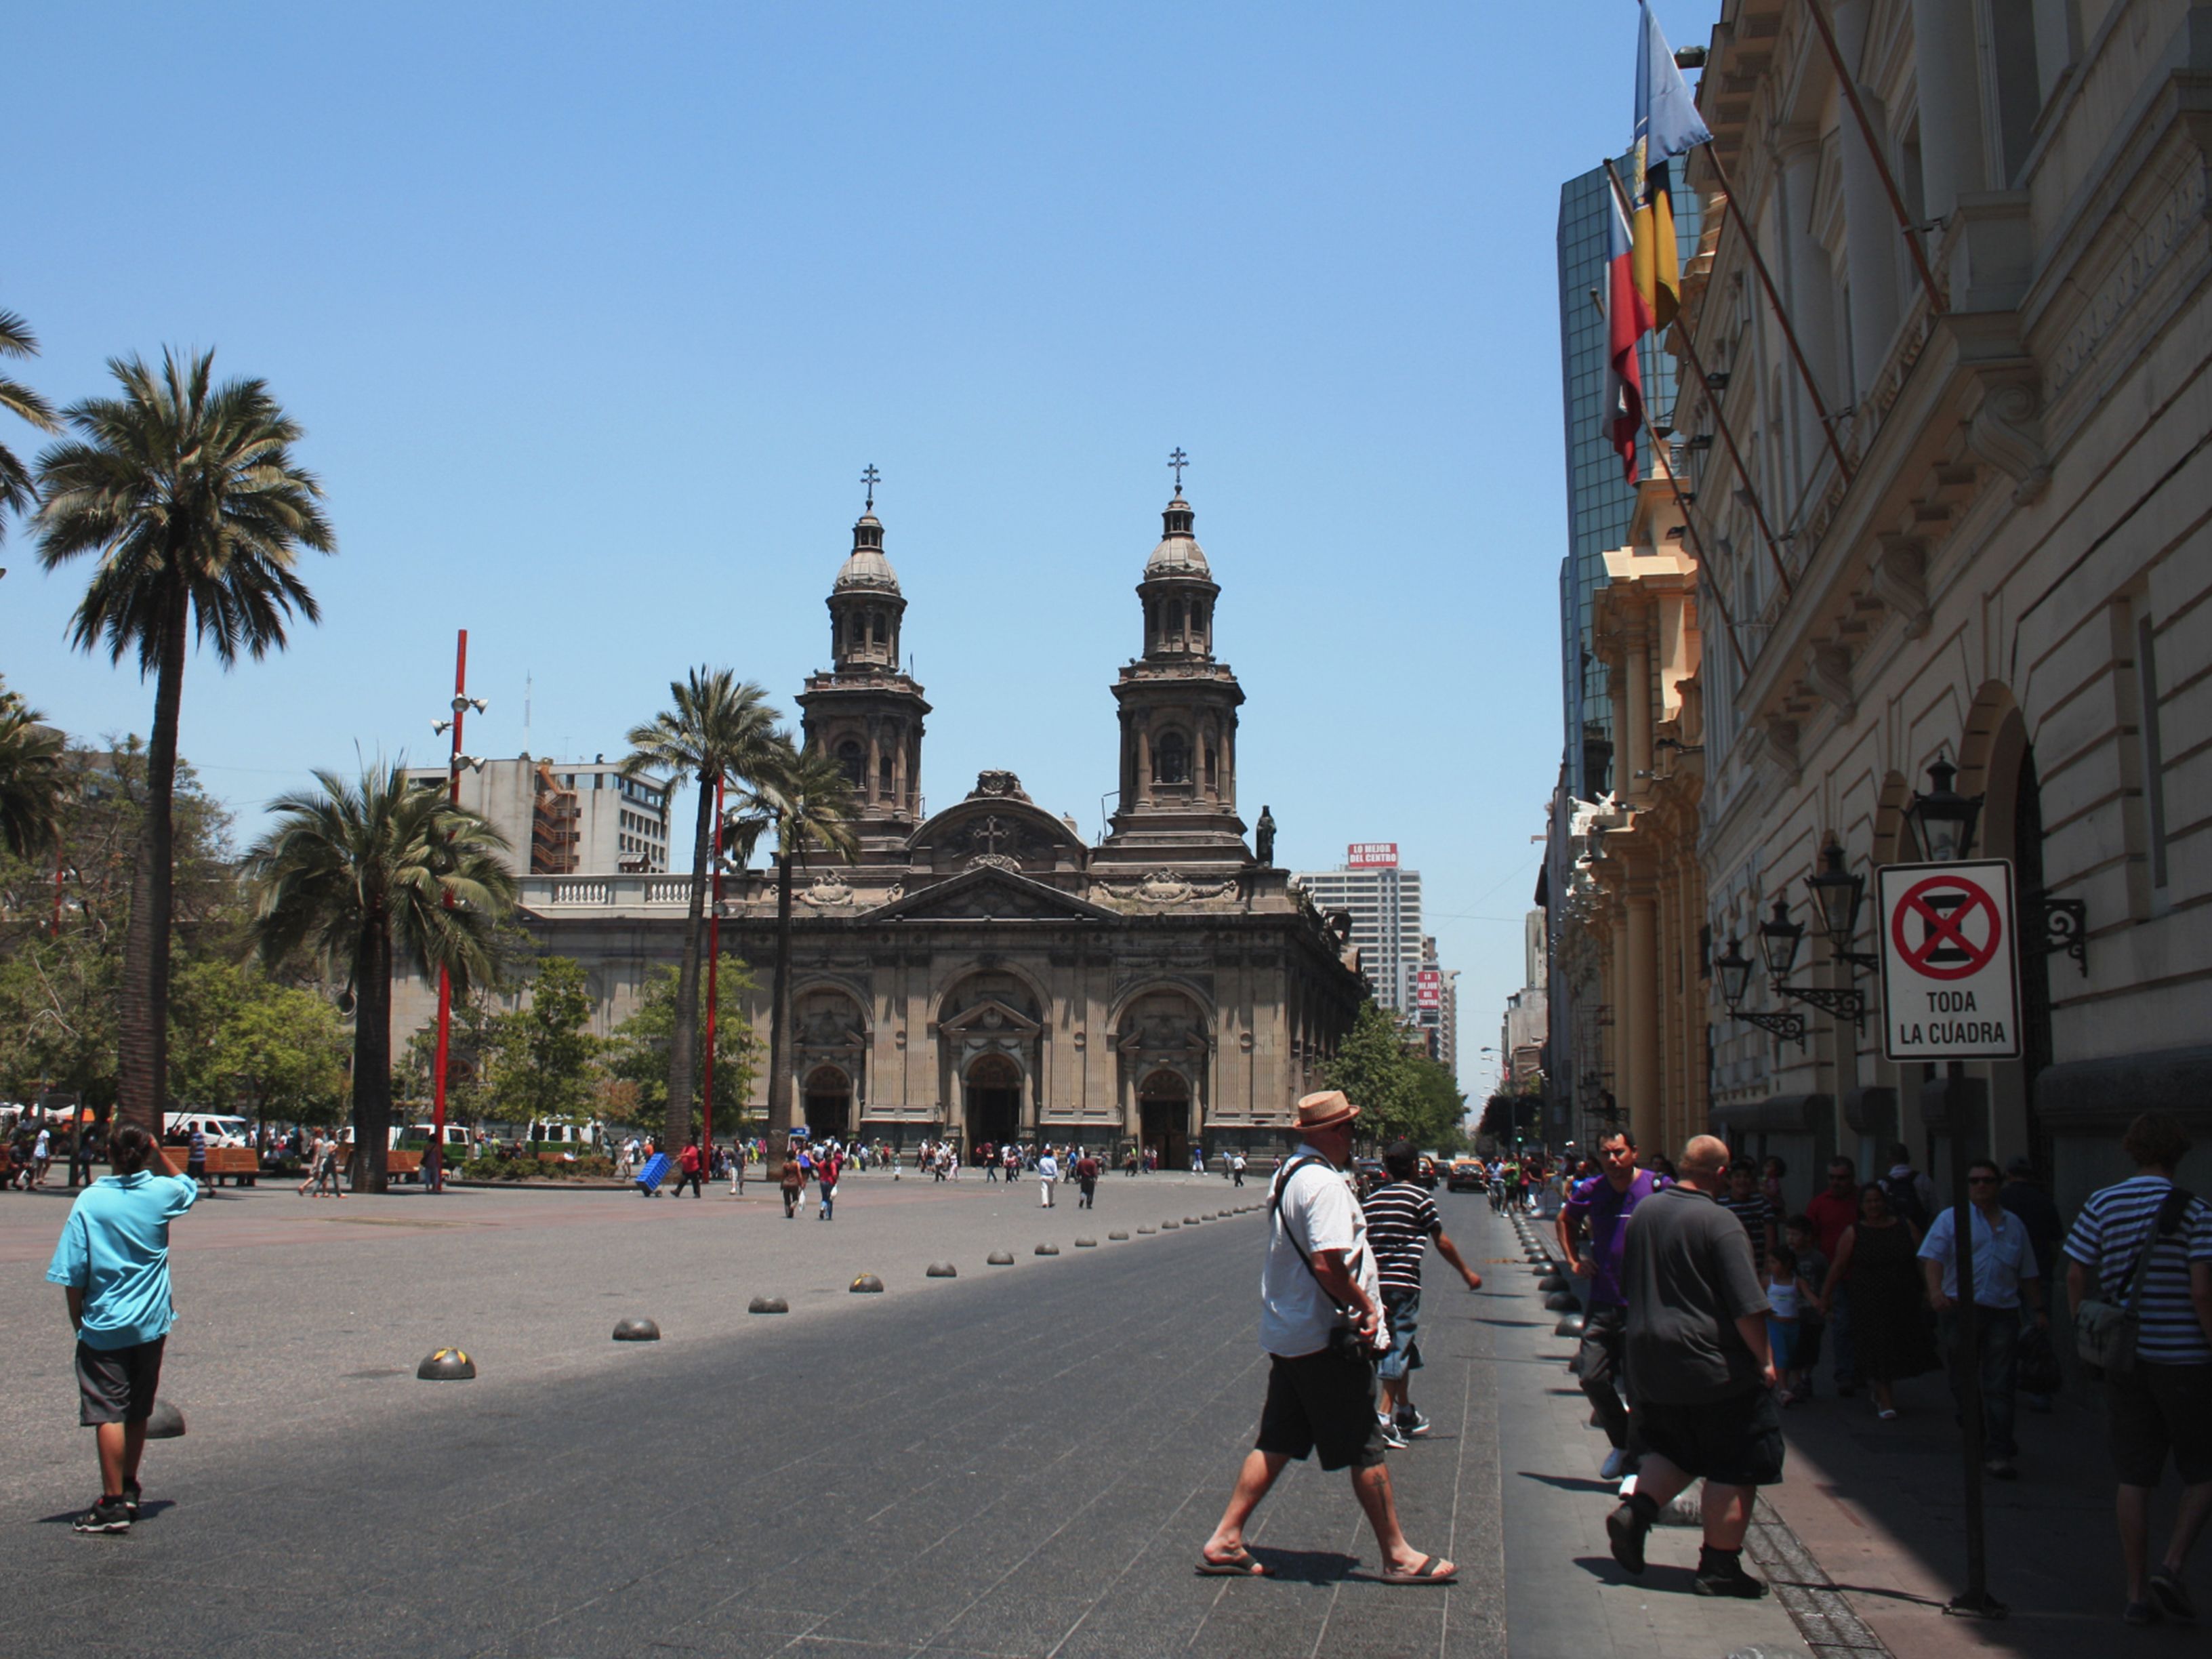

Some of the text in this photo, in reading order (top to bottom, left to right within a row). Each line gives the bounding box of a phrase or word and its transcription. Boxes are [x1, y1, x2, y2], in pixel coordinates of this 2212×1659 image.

[1353, 844, 1391, 853] LO MEJOR
[1350, 853, 1396, 863] DEL CENTRO
[1926, 991, 1977, 1012] TODA
[1900, 1022, 2006, 1044] LA CUADRA
